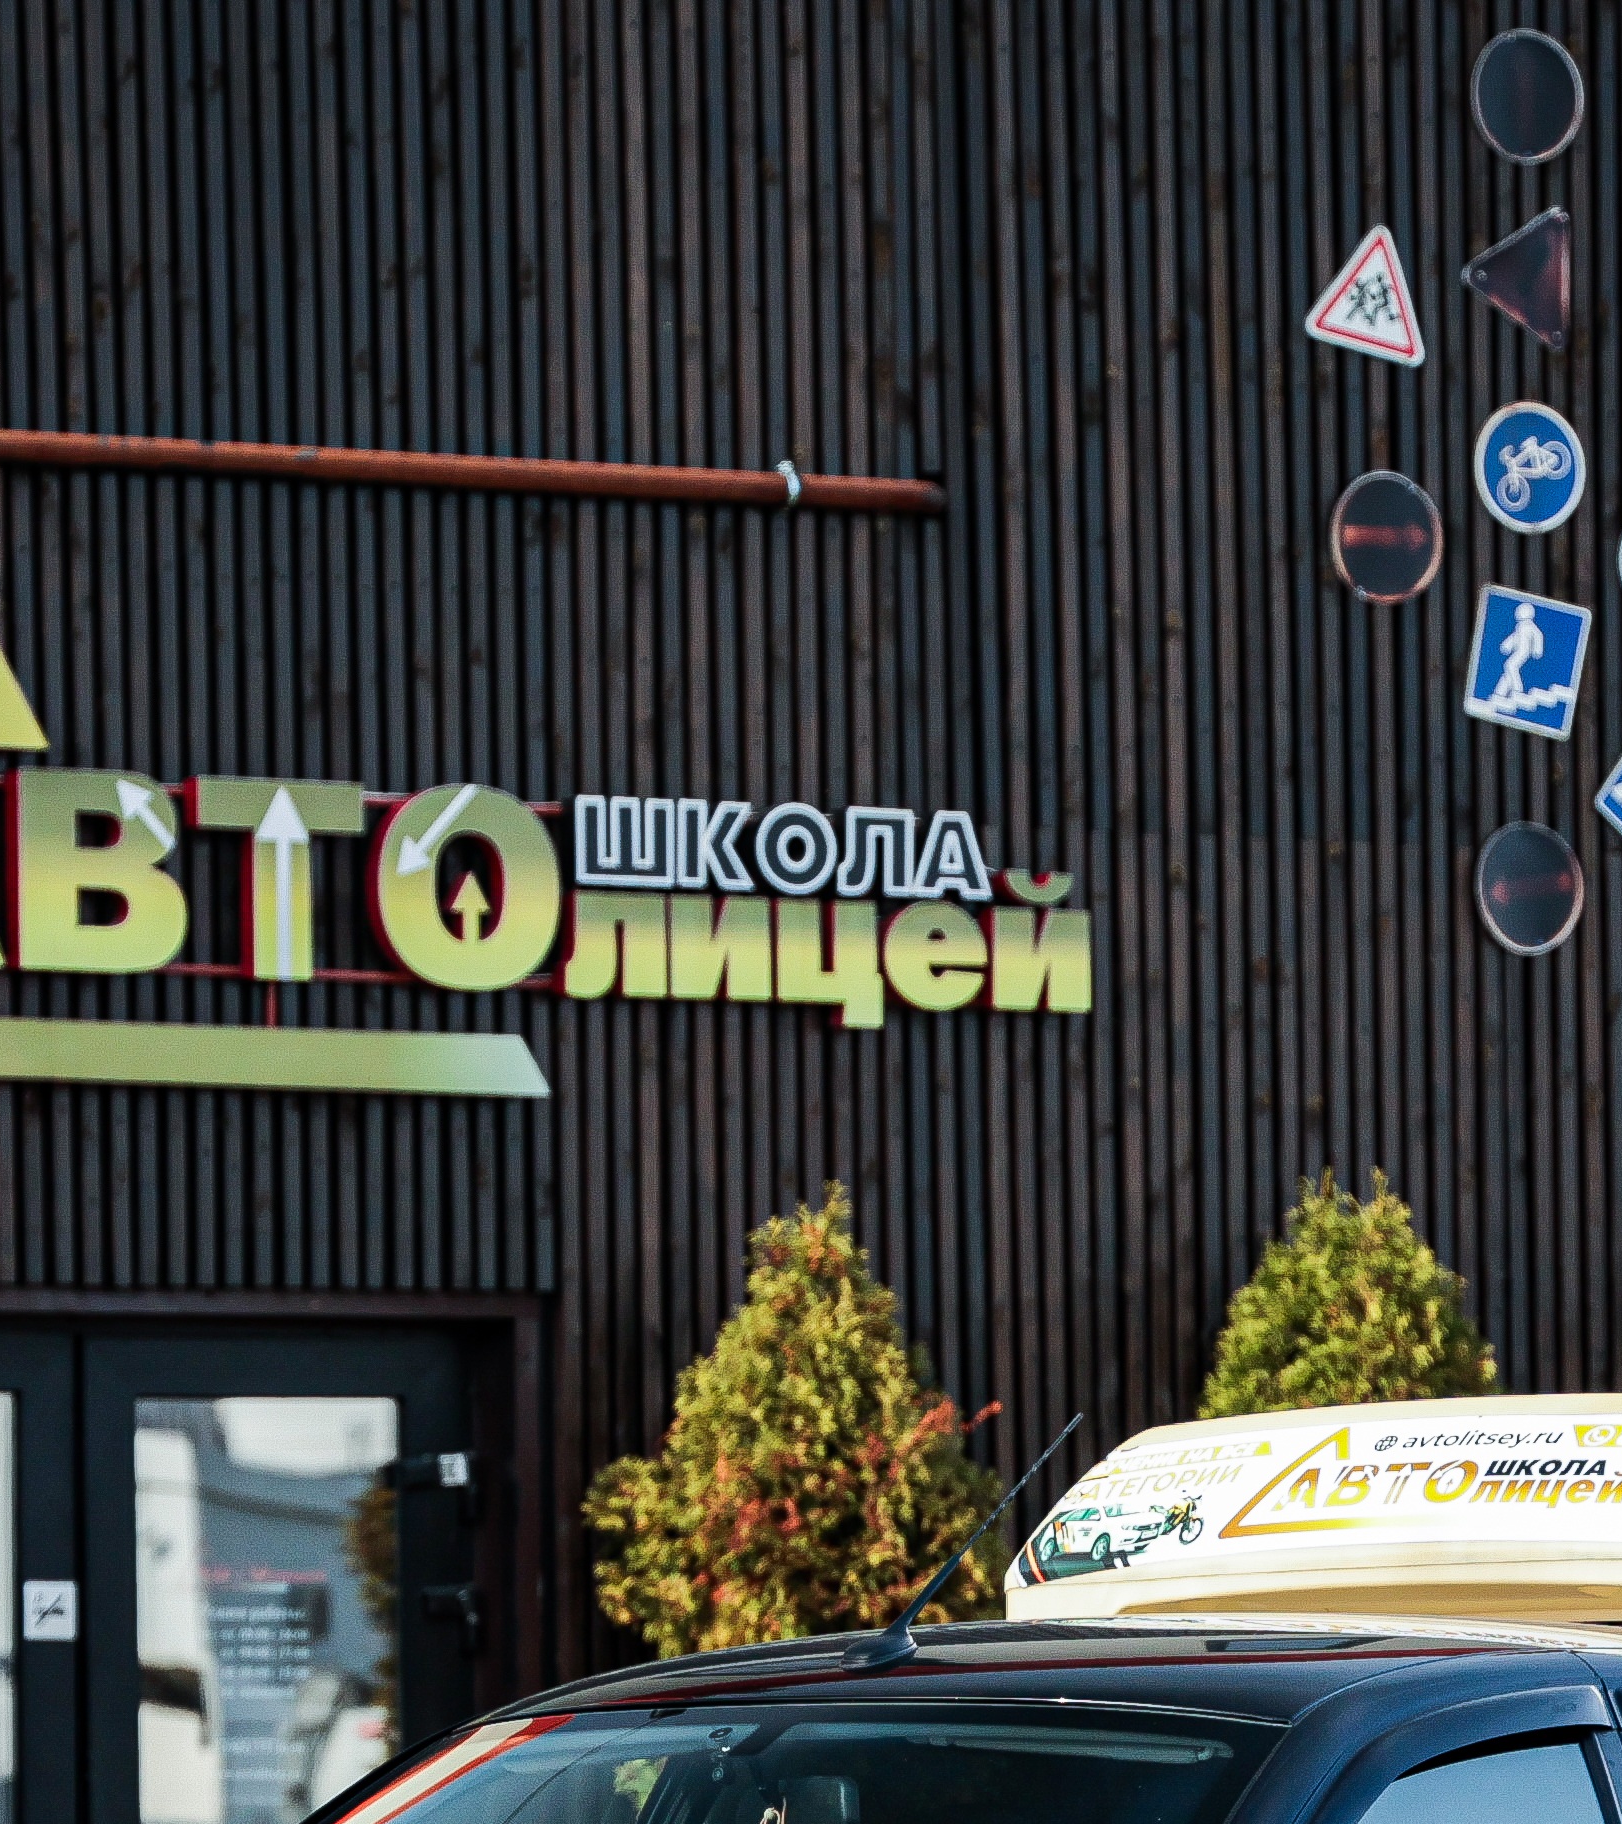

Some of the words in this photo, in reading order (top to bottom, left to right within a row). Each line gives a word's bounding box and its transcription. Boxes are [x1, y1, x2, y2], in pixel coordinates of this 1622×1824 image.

[574, 794, 992, 901] ШКОЛА
[1402, 1429, 1565, 1449] avtolitsey.ru
[1270, 1459, 1480, 1512] АВТО
[1484, 1459, 1607, 1477] ШКОЛА
